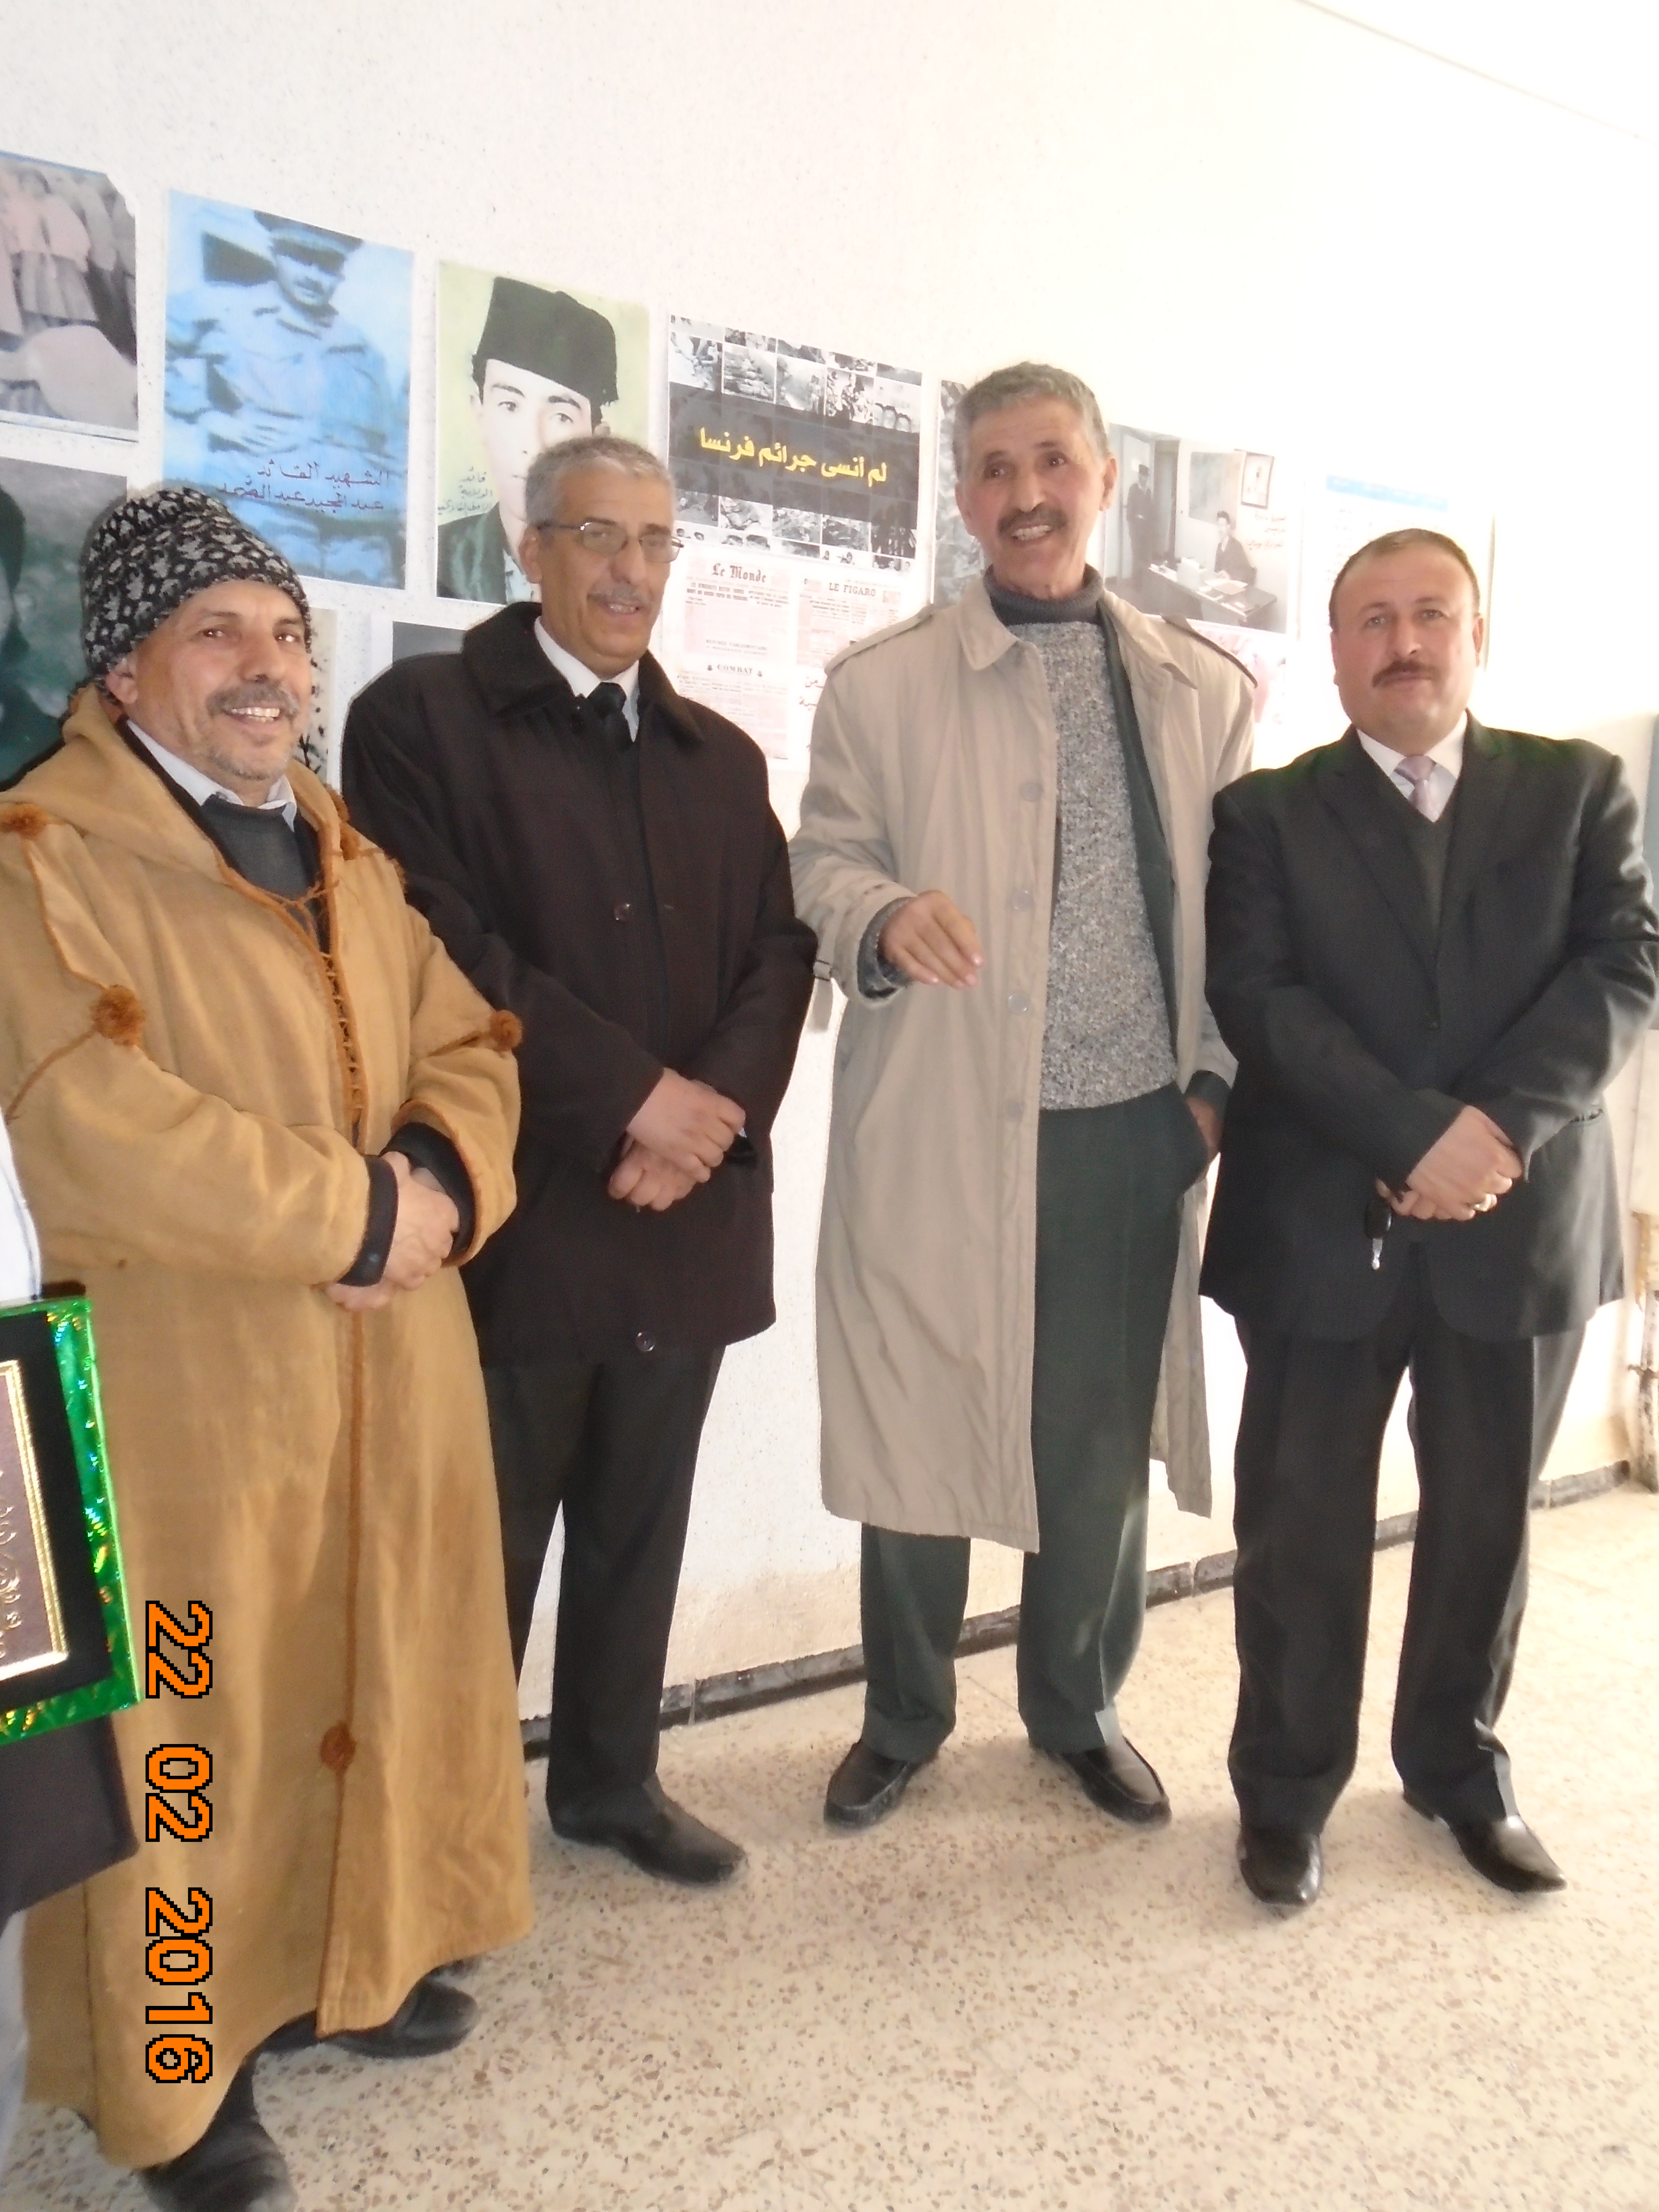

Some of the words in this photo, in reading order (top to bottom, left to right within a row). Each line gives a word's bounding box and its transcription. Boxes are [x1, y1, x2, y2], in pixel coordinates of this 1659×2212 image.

[700, 427, 755, 460] فرنسا
[758, 442, 817, 473] جرائم
[820, 456, 864, 477] أنسى
[868, 462, 887, 488] لم
[712, 563, 725, 576] Le
[729, 565, 766, 583] Monde
[829, 583, 839, 592] LE
[843, 585, 876, 597] FIGARO
[717, 664, 754, 675] COMBAT
